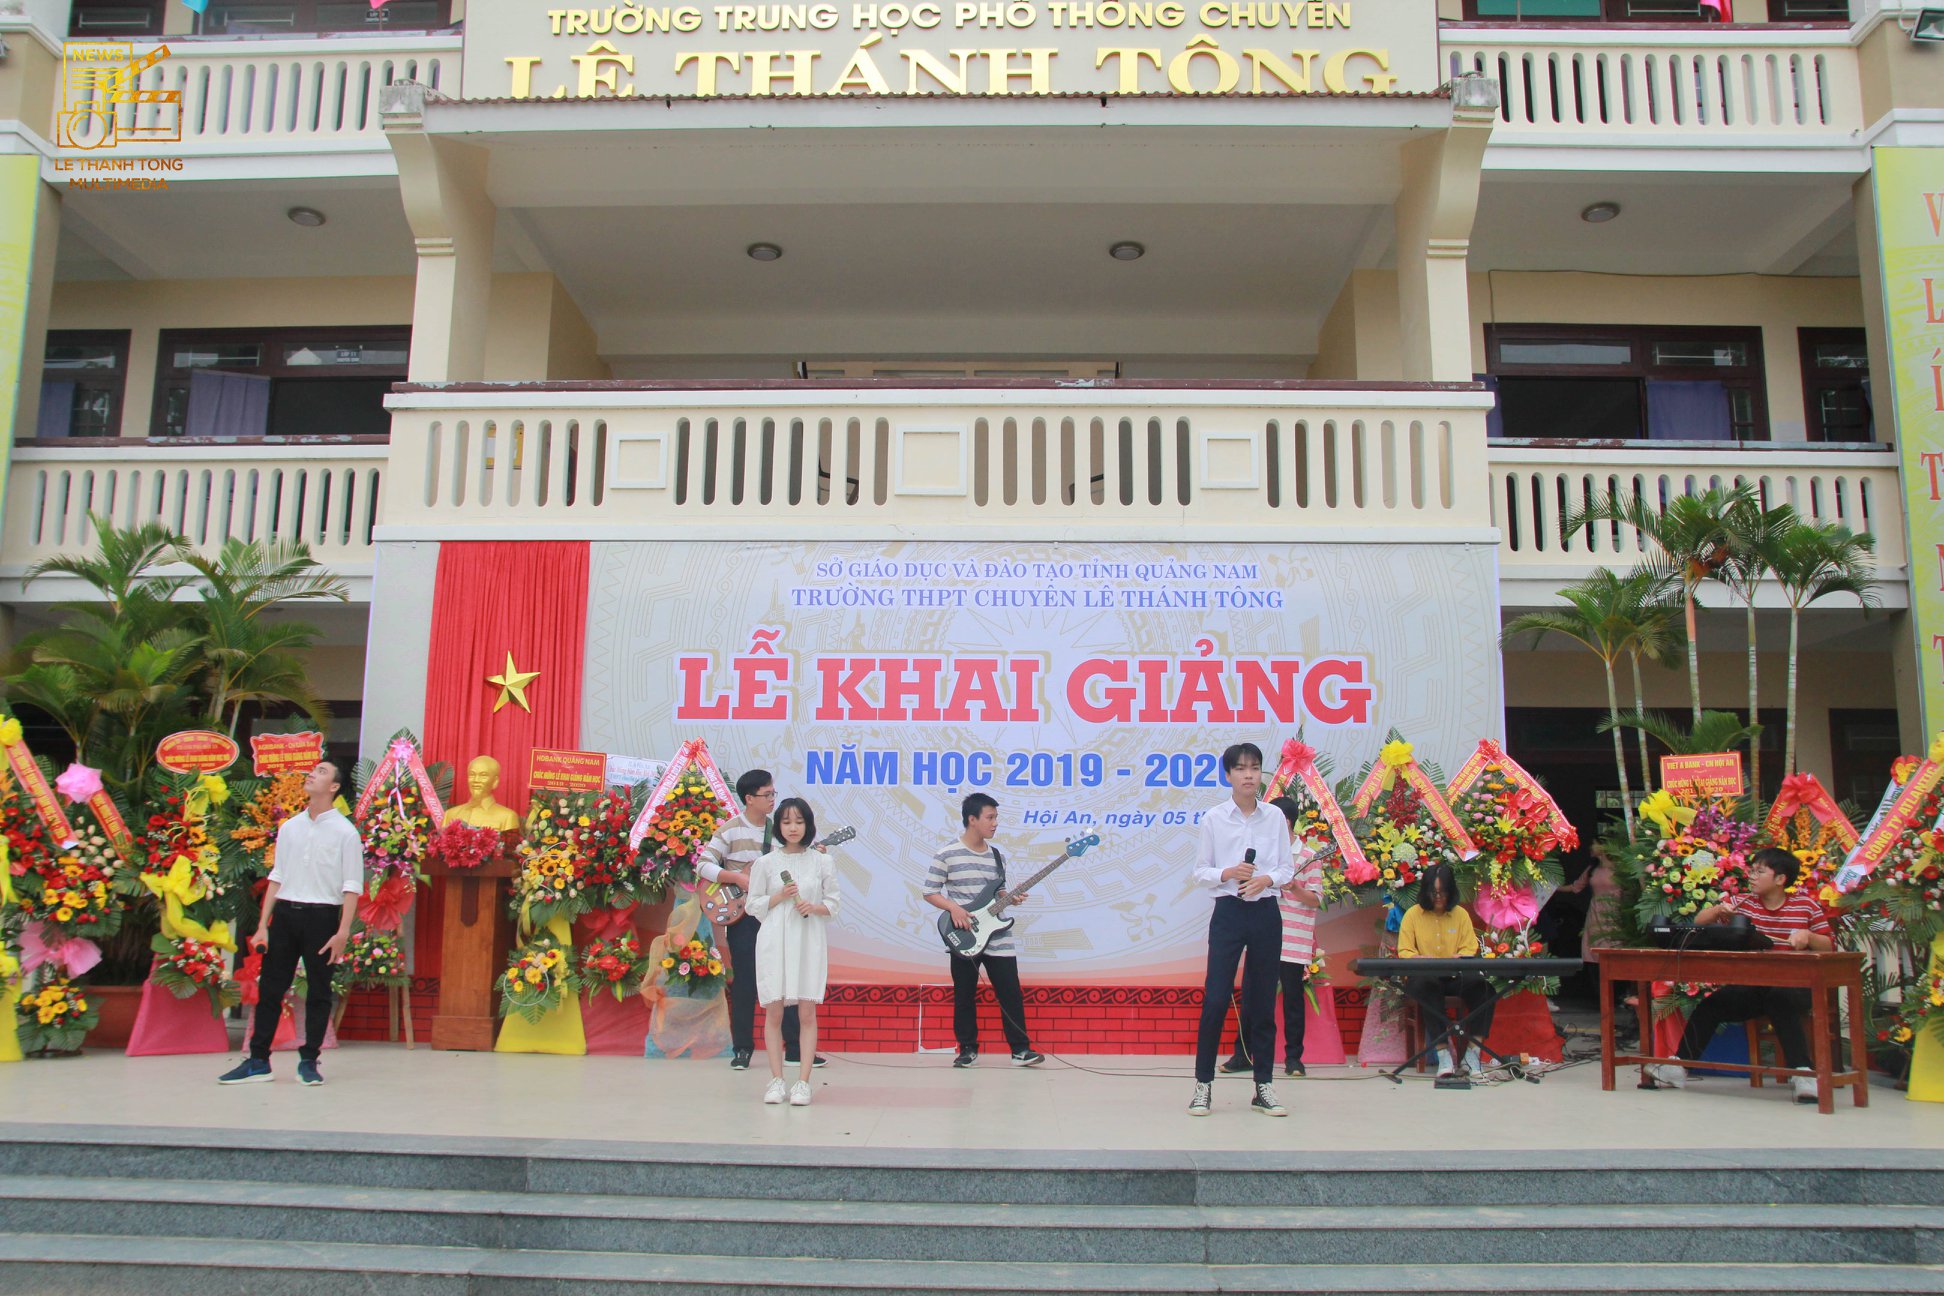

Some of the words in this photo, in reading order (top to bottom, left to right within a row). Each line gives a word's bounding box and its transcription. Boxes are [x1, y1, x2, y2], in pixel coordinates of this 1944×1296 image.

[548, 0, 701, 34] TRƯỜNG
[714, 4, 838, 32] TRUNG
[853, 4, 941, 36] HỌC
[504, 40, 634, 98] LÊ
[675, 32, 1058, 96] THÁNH
[1095, 34, 1397, 95] TÔNG
[816, 557, 843, 578] SỞ
[848, 559, 898, 578] GIÁO
[903, 563, 947, 581] DỤC
[953, 559, 979, 578] VÀ
[985, 559, 1027, 578] ĐÀO
[1033, 563, 1073, 581] TẠO
[1079, 558, 1128, 579] TỈNH
[1135, 558, 1207, 580] QUẢNG
[1213, 564, 1258, 579] NAM
[792, 582, 895, 606] TRƯỜNG
[902, 589, 967, 606] THPT
[975, 585, 1076, 607] CHUYÊN
[1084, 585, 1114, 607] LÊ
[1121, 585, 1207, 608] THÁNH
[1215, 586, 1283, 608] TÔNG
[677, 629, 789, 720] LỄ
[815, 658, 1040, 722] KHAI
[1066, 638, 1372, 724] GIẢNG
[806, 744, 898, 785] NĂM
[912, 751, 992, 793] HỌC
[1006, 753, 1103, 787] 2019
[1899, 766, 1936, 816] ATLANTIC
[1024, 810, 1058, 829] Hội
[1064, 810, 1097, 829] An,
[1105, 810, 1155, 828] ngày
[1162, 811, 1186, 825] 05
